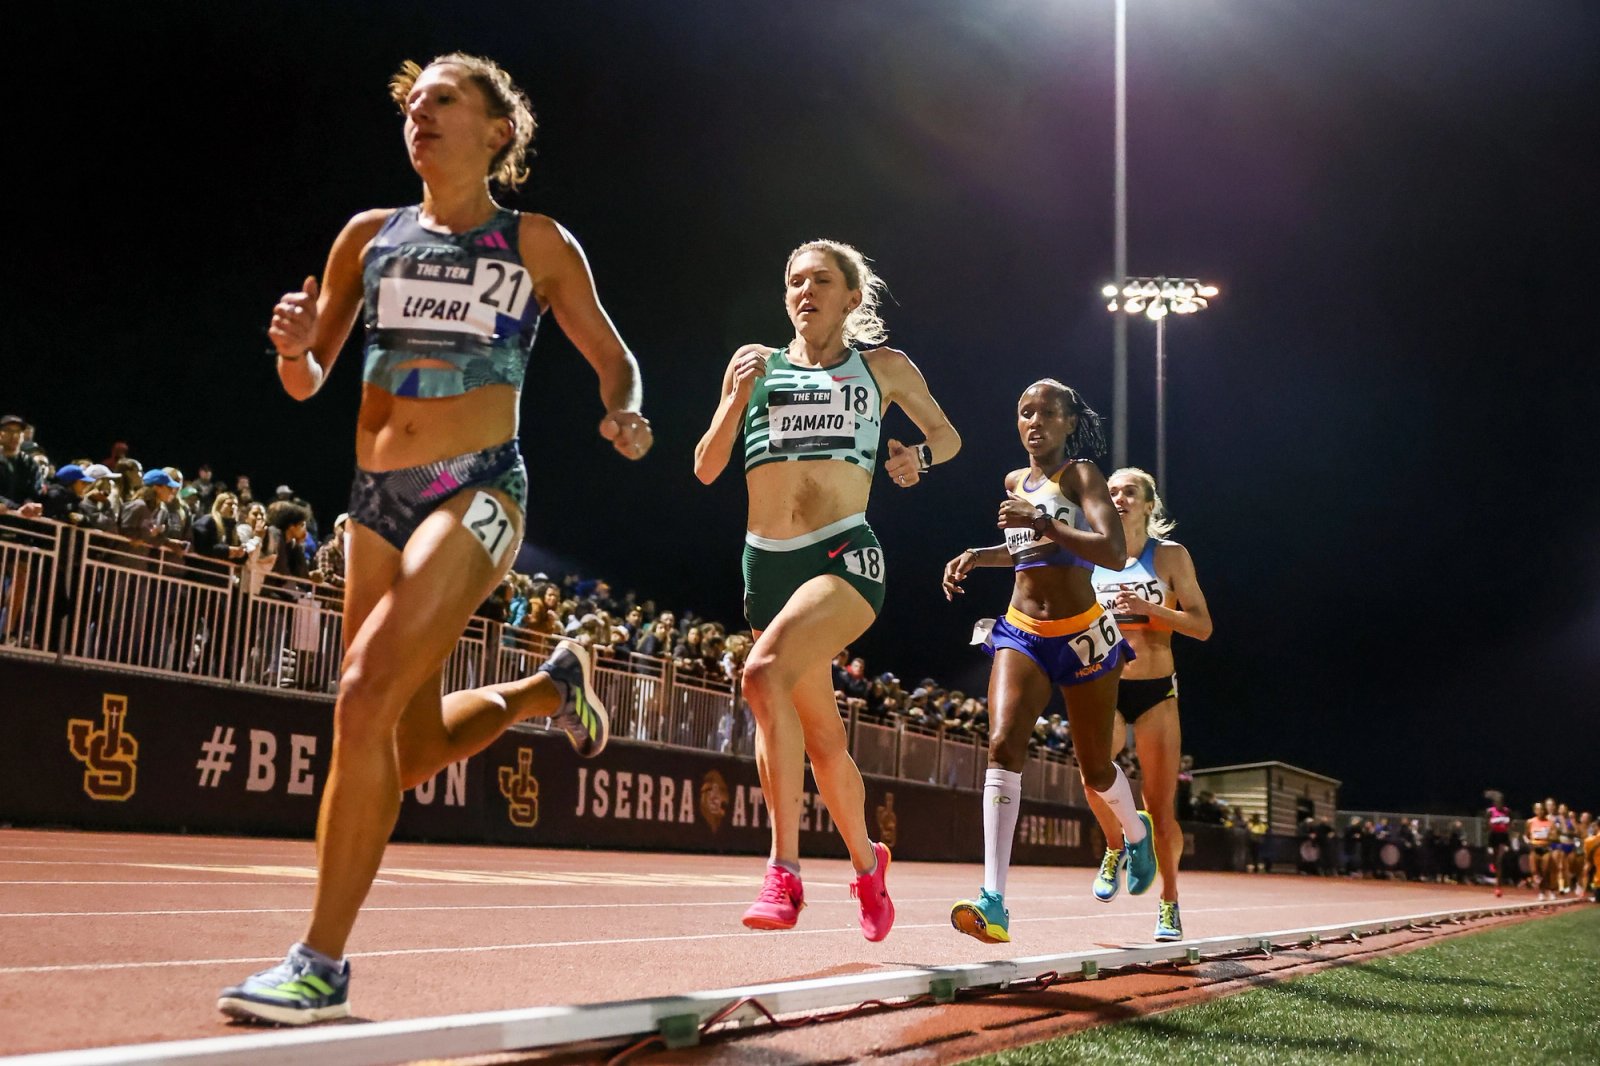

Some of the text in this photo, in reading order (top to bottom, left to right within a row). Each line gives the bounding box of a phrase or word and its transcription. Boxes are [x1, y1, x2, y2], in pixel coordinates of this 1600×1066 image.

[416, 263, 470, 280] THE TEN
[479, 262, 524, 313] 21
[403, 296, 470, 322] LIPARI
[792, 392, 831, 402] THE TEN
[840, 384, 869, 415] 18
[781, 414, 845, 432] D'AMATO
[471, 498, 508, 555] 21
[852, 548, 880, 579] 18
[1075, 615, 1116, 665] 26
[1075, 661, 1103, 679] HOKA
[576, 768, 696, 824] JSERRA
